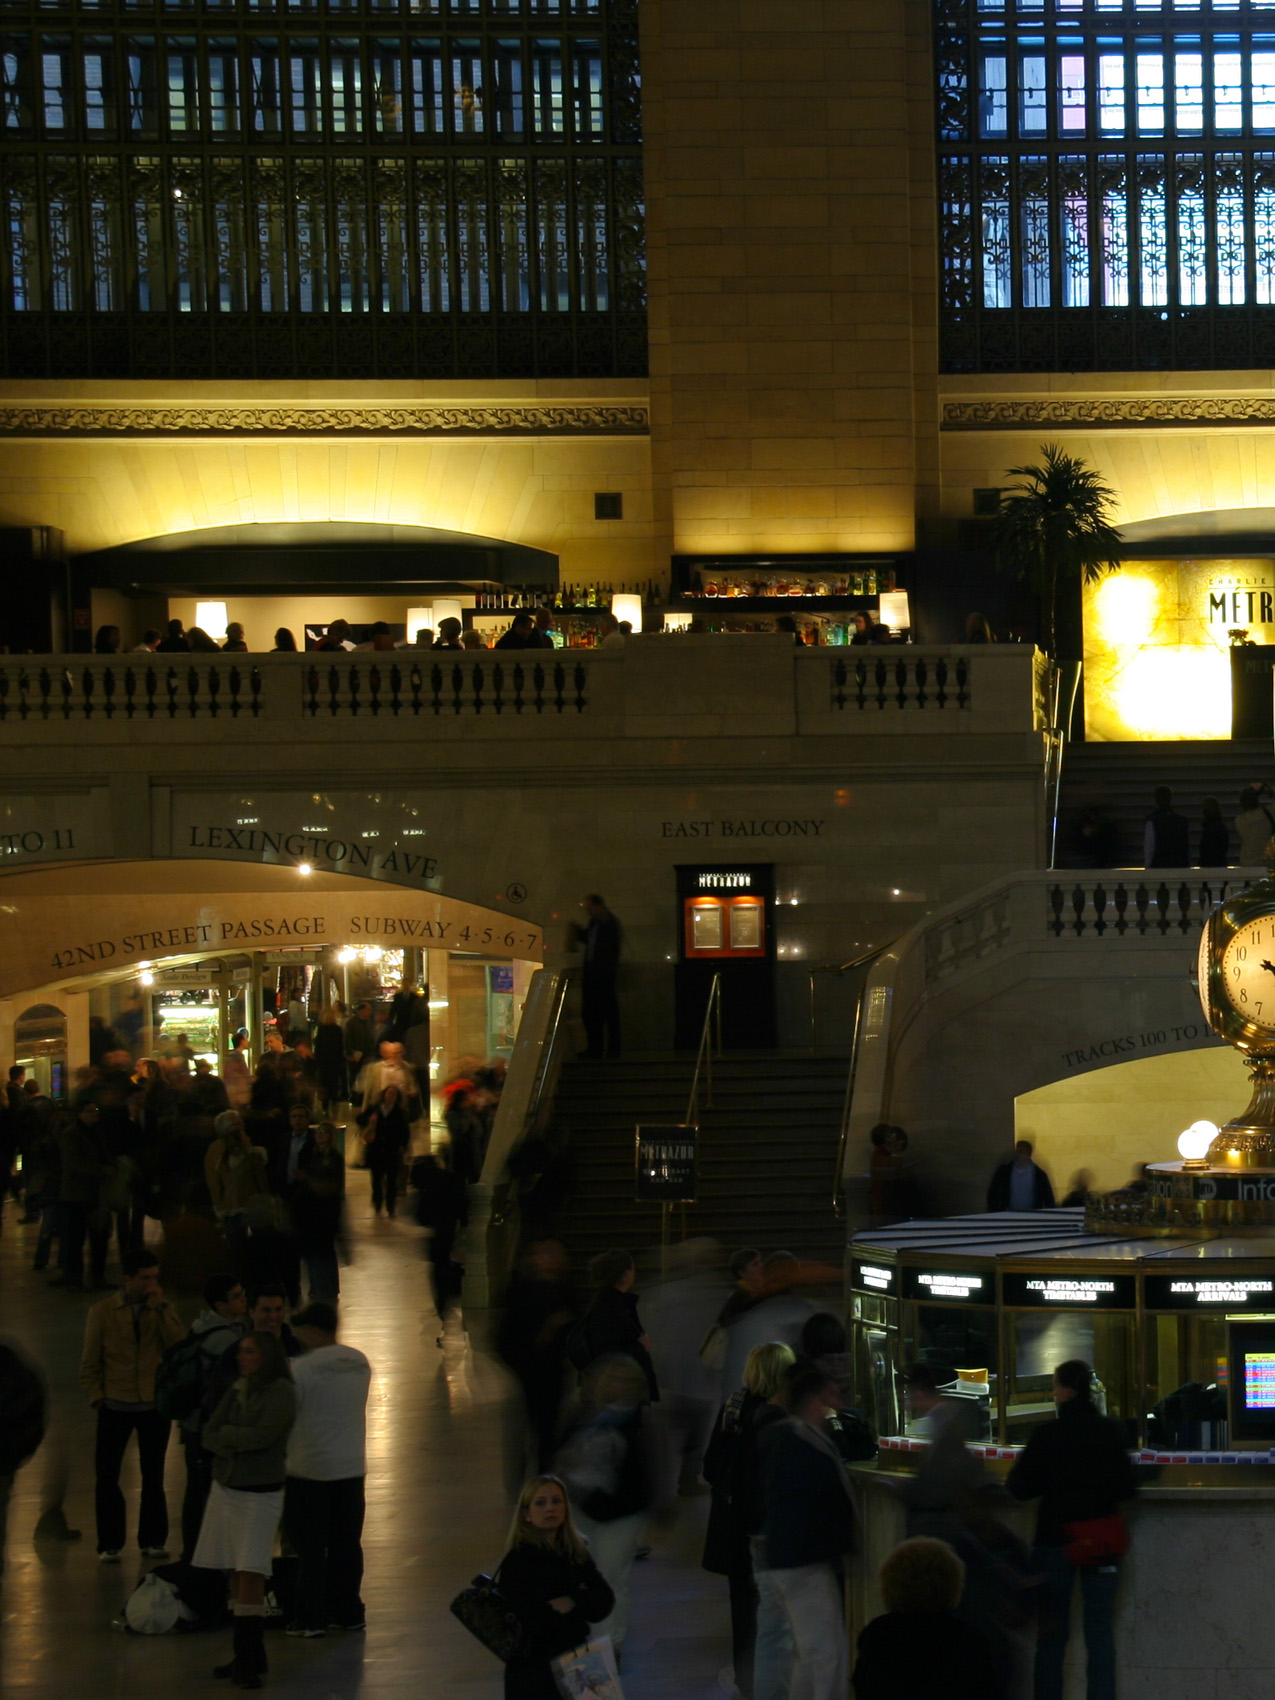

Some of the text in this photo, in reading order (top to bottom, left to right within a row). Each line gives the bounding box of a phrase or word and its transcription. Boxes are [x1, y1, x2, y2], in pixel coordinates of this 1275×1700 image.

[1209, 577, 1266, 585] CHARLIE
[661, 819, 825, 838] EAST BALCONY
[1, 828, 75, 854] TO 11
[189, 825, 438, 880] LEXINGTON AVE
[51, 939, 116, 970] 42ND
[123, 924, 213, 953] STREET
[221, 916, 326, 941] PASSAGE
[350, 915, 452, 940] SUBWAY
[1251, 931, 1261, 945] 11
[1236, 946, 1247, 961] 10
[1233, 966, 1241, 982] 9
[1240, 988, 1248, 1003] 8
[1255, 1001, 1263, 1015] 7
[1062, 1035, 1136, 1067] TRACKS
[1141, 1030, 1167, 1048] 100
[1171, 1024, 1198, 1042] TO
[1026, 1280, 1046, 1290] MTA
[1171, 1282, 1194, 1292] MTA
[1197, 1291, 1248, 1302] ARRIVALS
